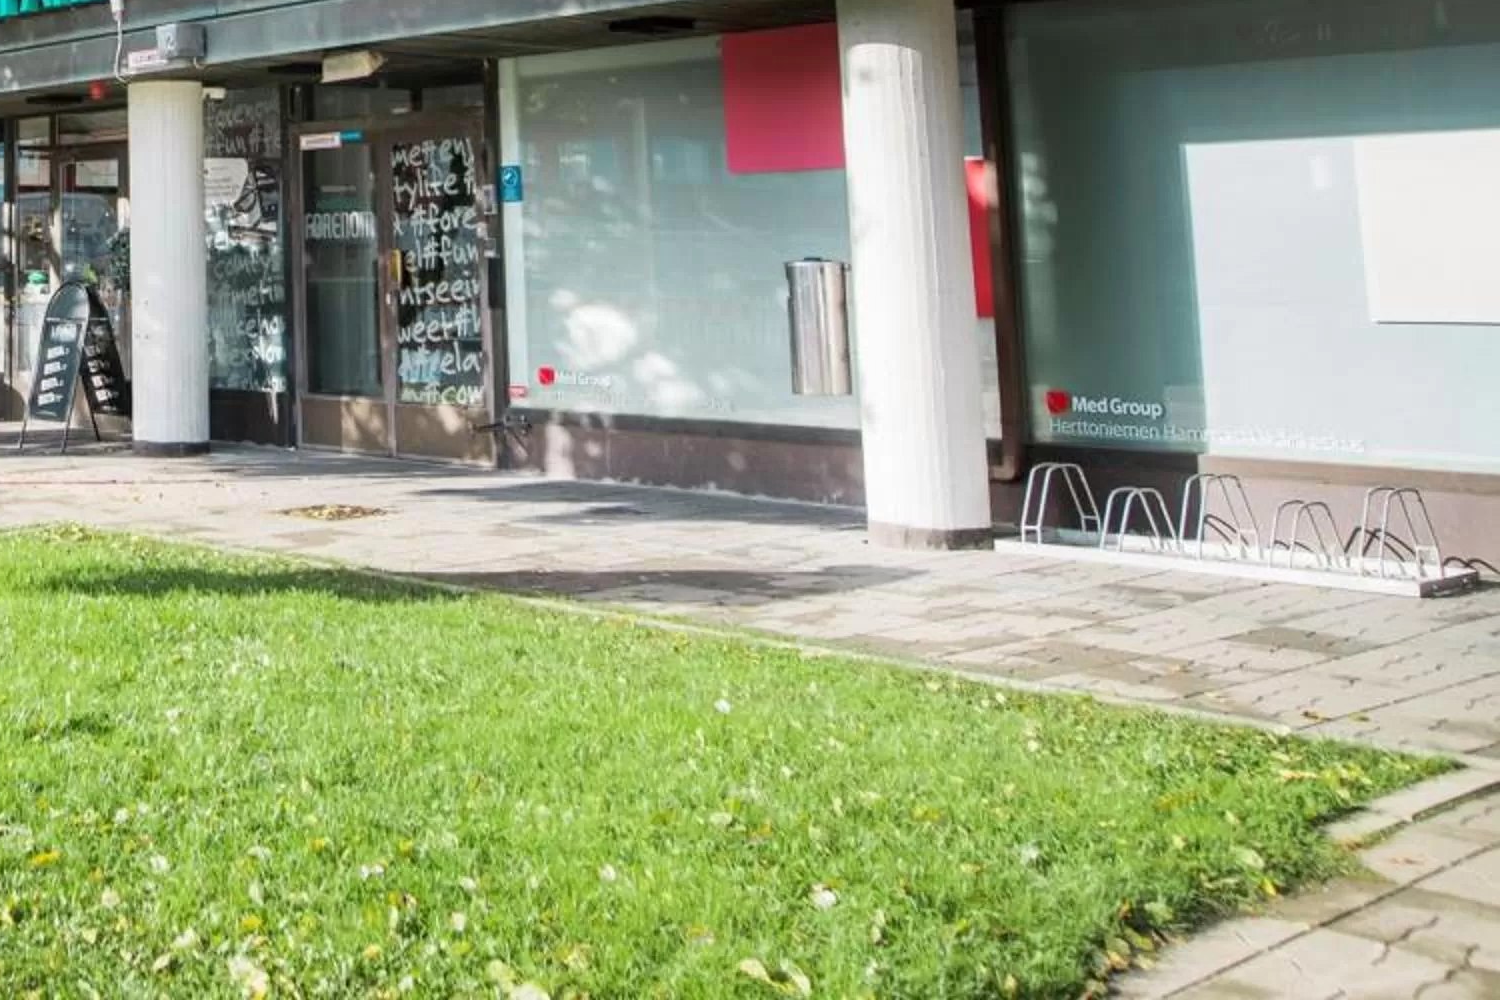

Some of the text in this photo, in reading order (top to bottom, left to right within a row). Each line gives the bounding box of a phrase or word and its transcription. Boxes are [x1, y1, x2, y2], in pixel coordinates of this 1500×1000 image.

[1071, 395, 1163, 419] Med Group
[1050, 417, 1160, 440] Herttoniemen
